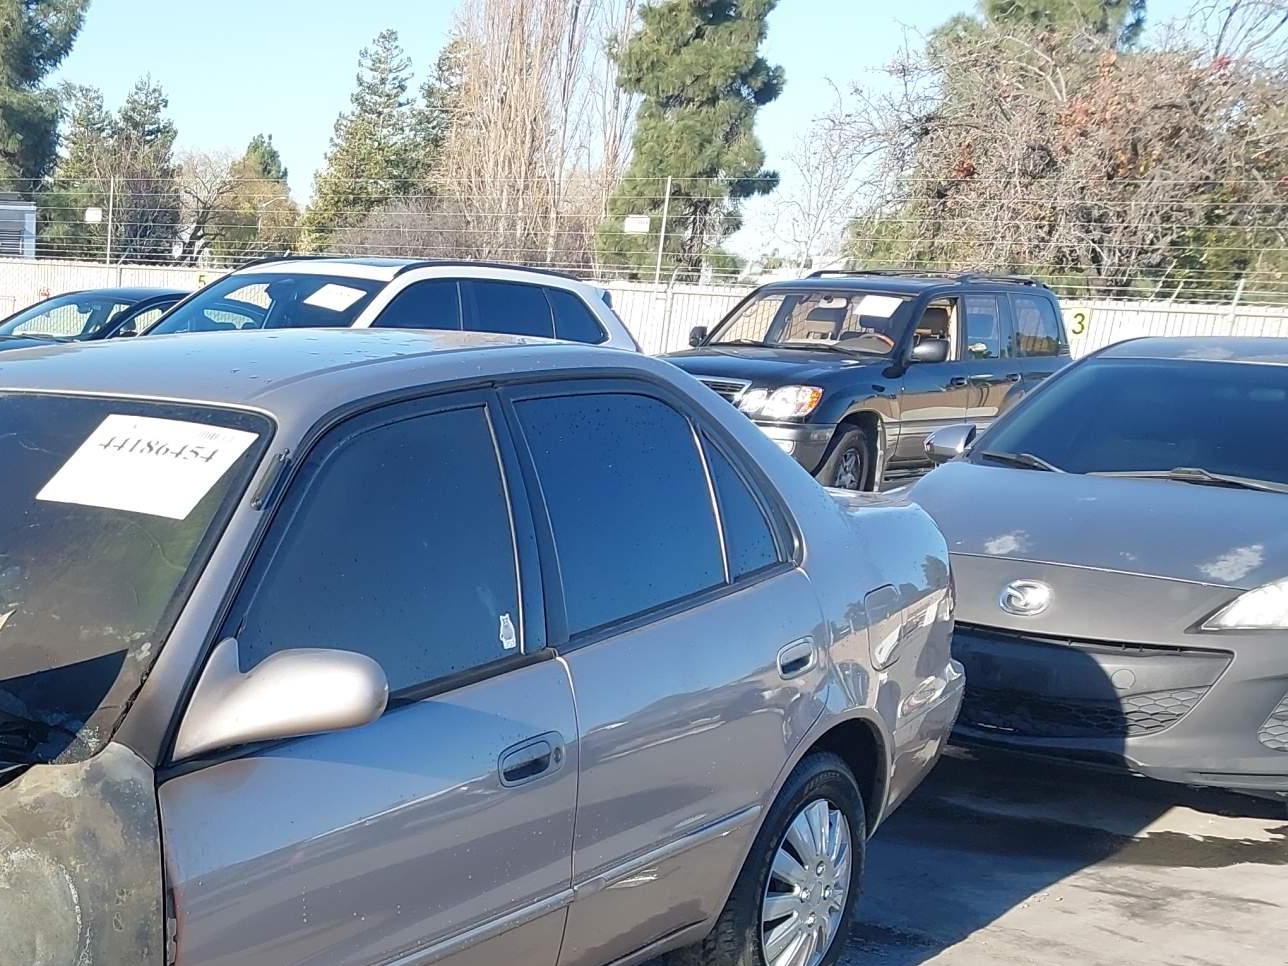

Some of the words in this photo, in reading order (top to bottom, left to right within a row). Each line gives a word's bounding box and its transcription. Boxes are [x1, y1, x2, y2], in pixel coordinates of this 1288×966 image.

[198, 274, 206, 289] 5
[1071, 312, 1085, 335] 3
[98, 435, 219, 463] 44186454
